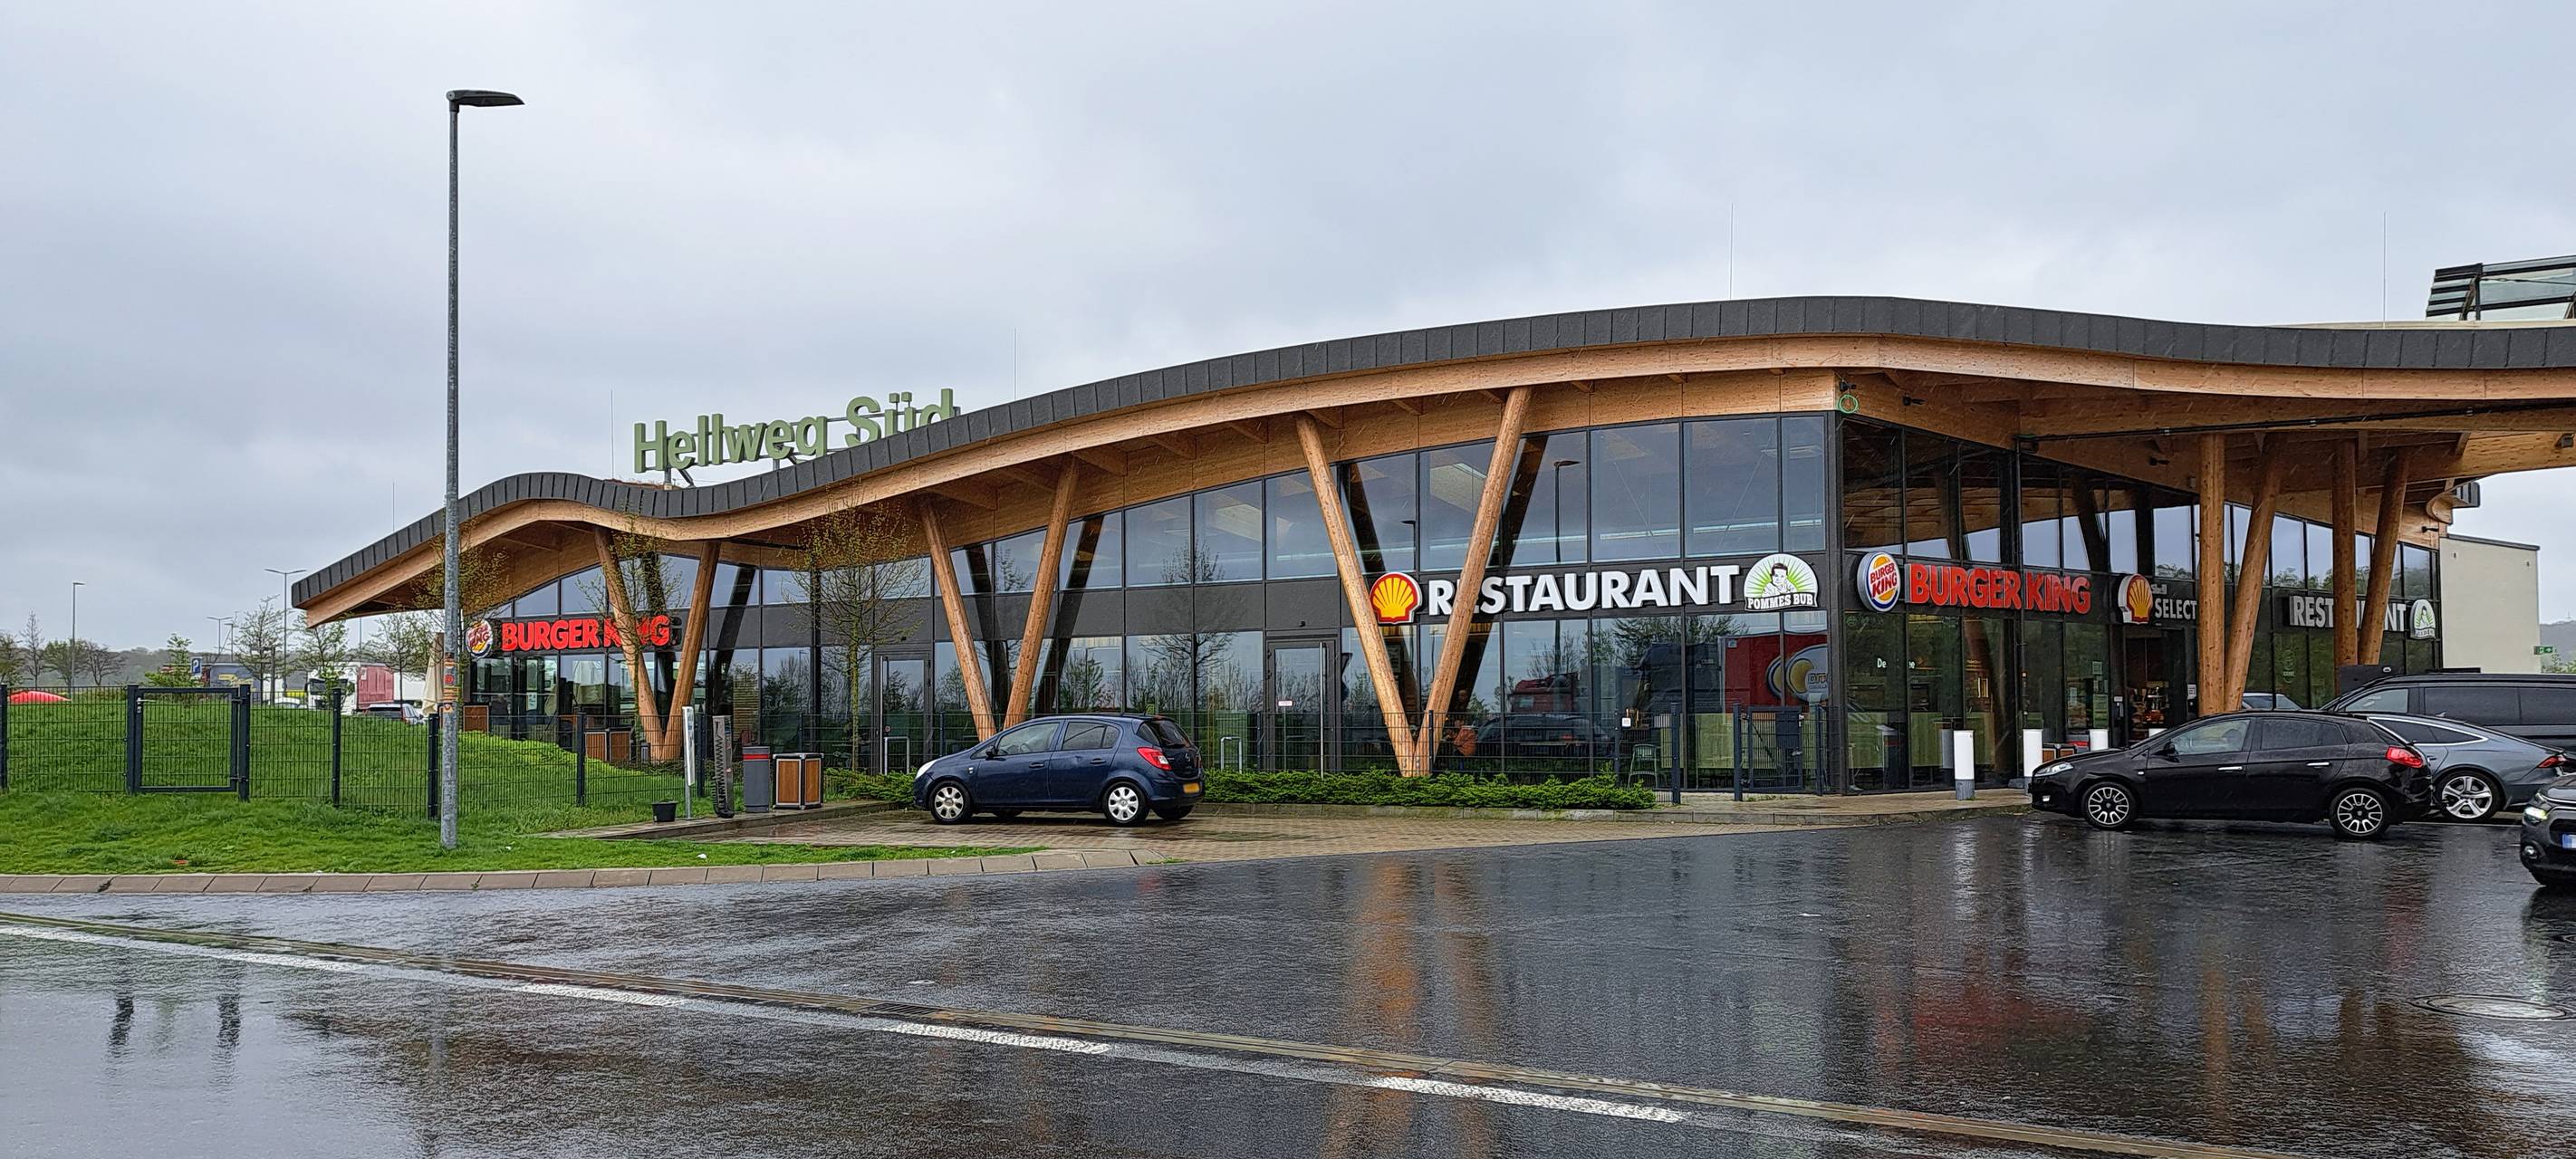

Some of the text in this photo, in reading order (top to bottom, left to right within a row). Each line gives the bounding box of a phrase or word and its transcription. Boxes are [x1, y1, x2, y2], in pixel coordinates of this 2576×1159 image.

[634, 388, 954, 474] Hellweg Süd
[1428, 565, 1740, 616] RSTAURANT
[1870, 562, 1896, 584] BURGER
[1872, 572, 1898, 598] KING
[1906, 563, 2091, 614] BURGER KING
[1747, 593, 1813, 609] POMMES BUB
[2155, 598, 2197, 619] SELECT
[2289, 595, 2407, 633] RESTNT
[501, 618, 600, 652] BURGER
[603, 615, 670, 647] KNG
